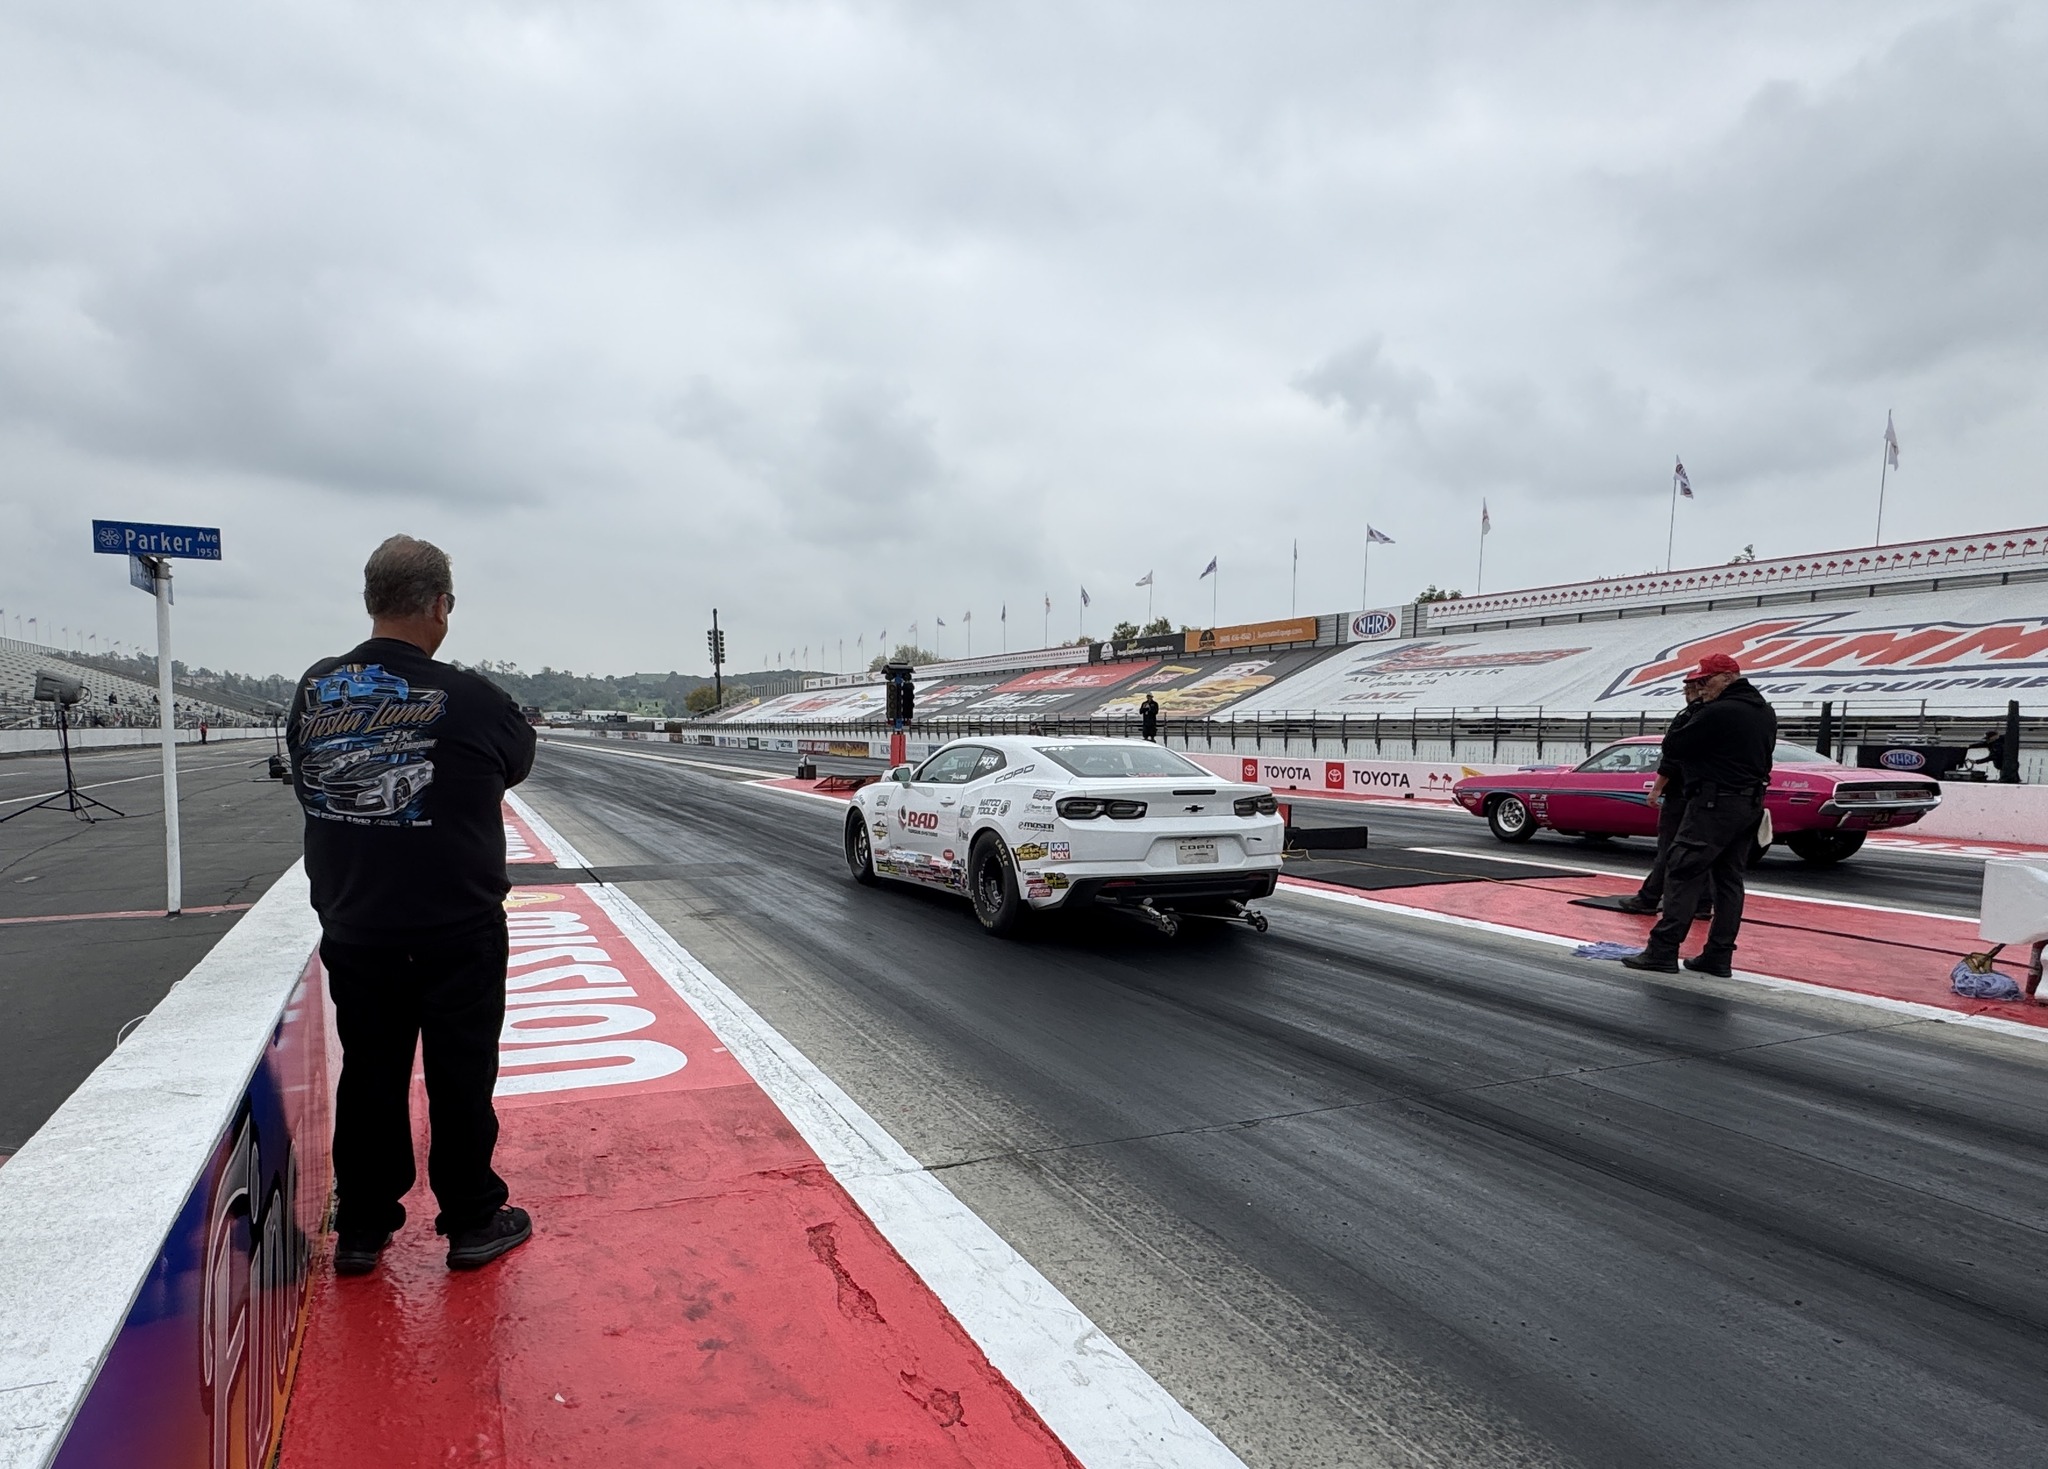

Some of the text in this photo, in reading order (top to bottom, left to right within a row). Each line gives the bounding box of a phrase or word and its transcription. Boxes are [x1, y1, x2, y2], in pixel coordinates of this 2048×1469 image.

[124, 529, 218, 552] Parker Ave
[196, 547, 219, 557] 1950
[1358, 615, 1390, 633] NHRA
[1344, 668, 1504, 683] AUTO CENTER
[1339, 690, 1426, 701] GMC
[300, 691, 446, 746] Justin Lamb
[1888, 752, 1918, 765] NHRA
[994, 764, 1036, 784] COPO
[1264, 765, 1312, 781] TOYOTA
[1352, 770, 1410, 788] TOYOTA
[979, 798, 1002, 807] MATCO
[977, 806, 998, 816] TOOLS
[907, 811, 939, 830] RAD
[1023, 822, 1055, 830] MOSER
[994, 839, 1009, 868] EAGLE
[1051, 851, 1070, 860] MOLY
